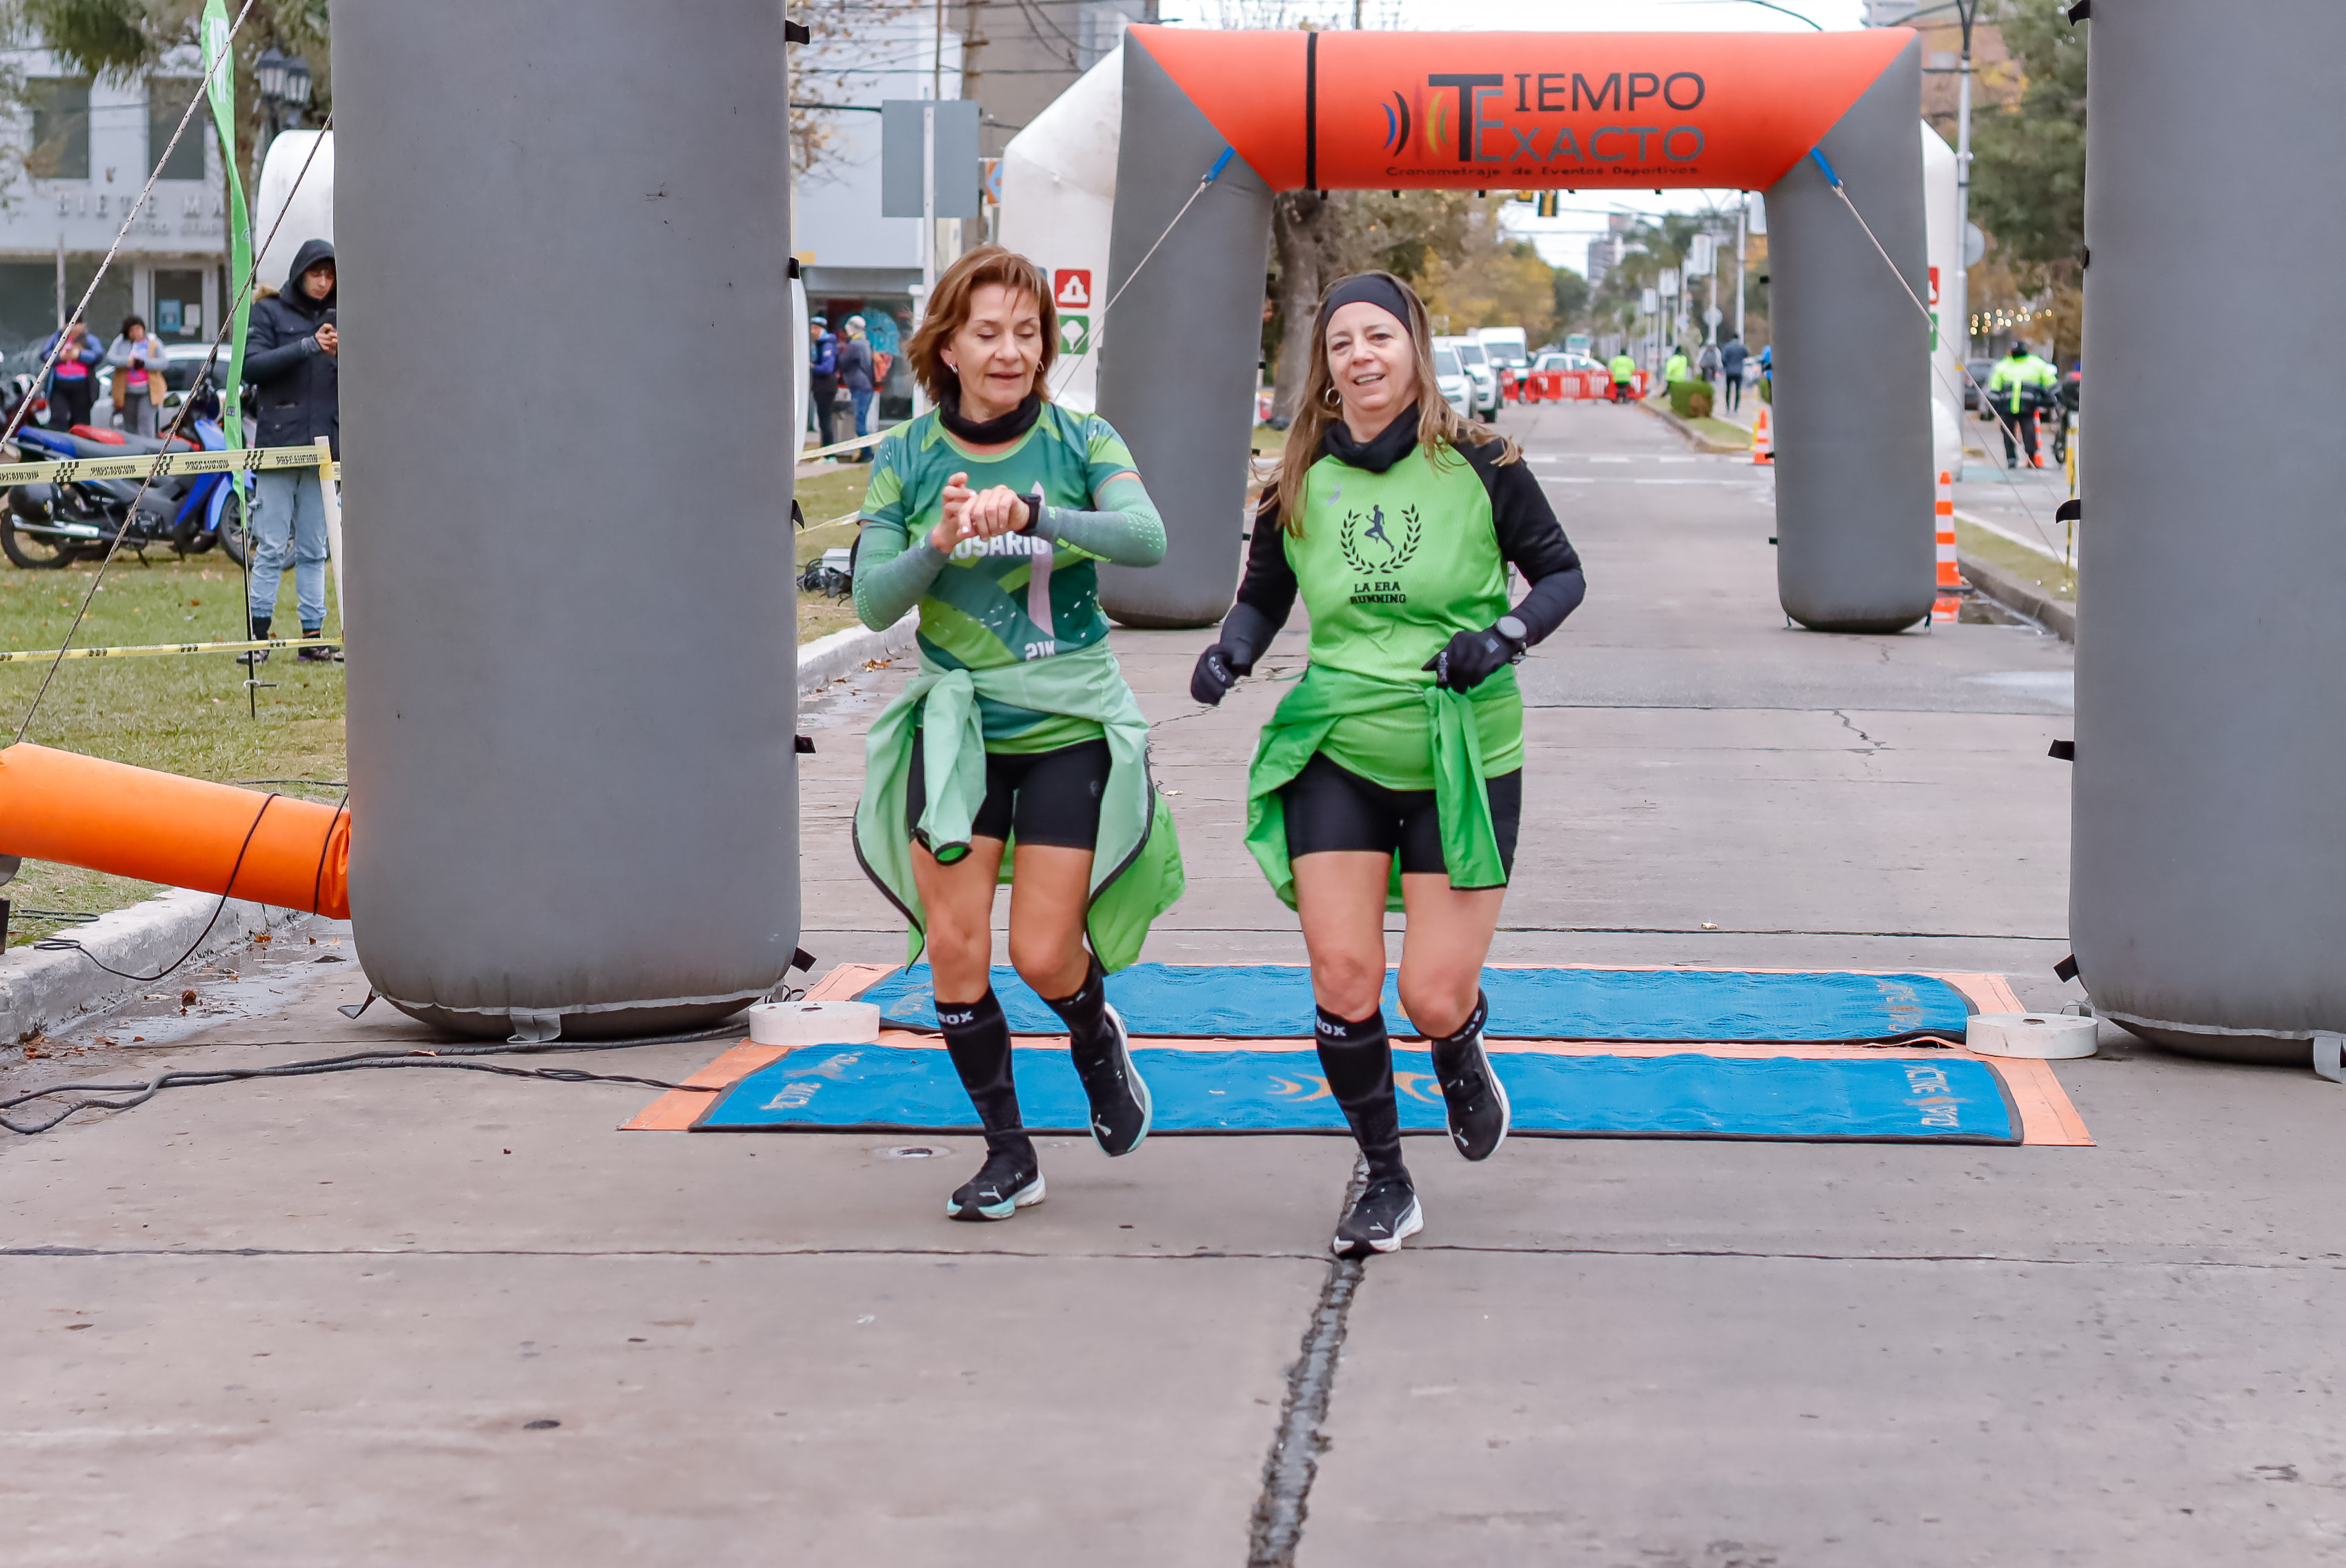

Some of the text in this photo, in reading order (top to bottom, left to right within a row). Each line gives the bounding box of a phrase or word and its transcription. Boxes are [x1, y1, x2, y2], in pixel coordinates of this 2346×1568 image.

[1428, 72, 1706, 162] TIEMPO
[1474, 88, 1705, 162] EXACTO
[1512, 168, 1532, 176] de
[1541, 167, 1604, 176] Eventos
[1613, 166, 1699, 177] Deportivos
[951, 530, 1052, 560] OSARIO
[1354, 582, 1401, 593] LA ERA
[1350, 593, 1406, 604] RUNNING
